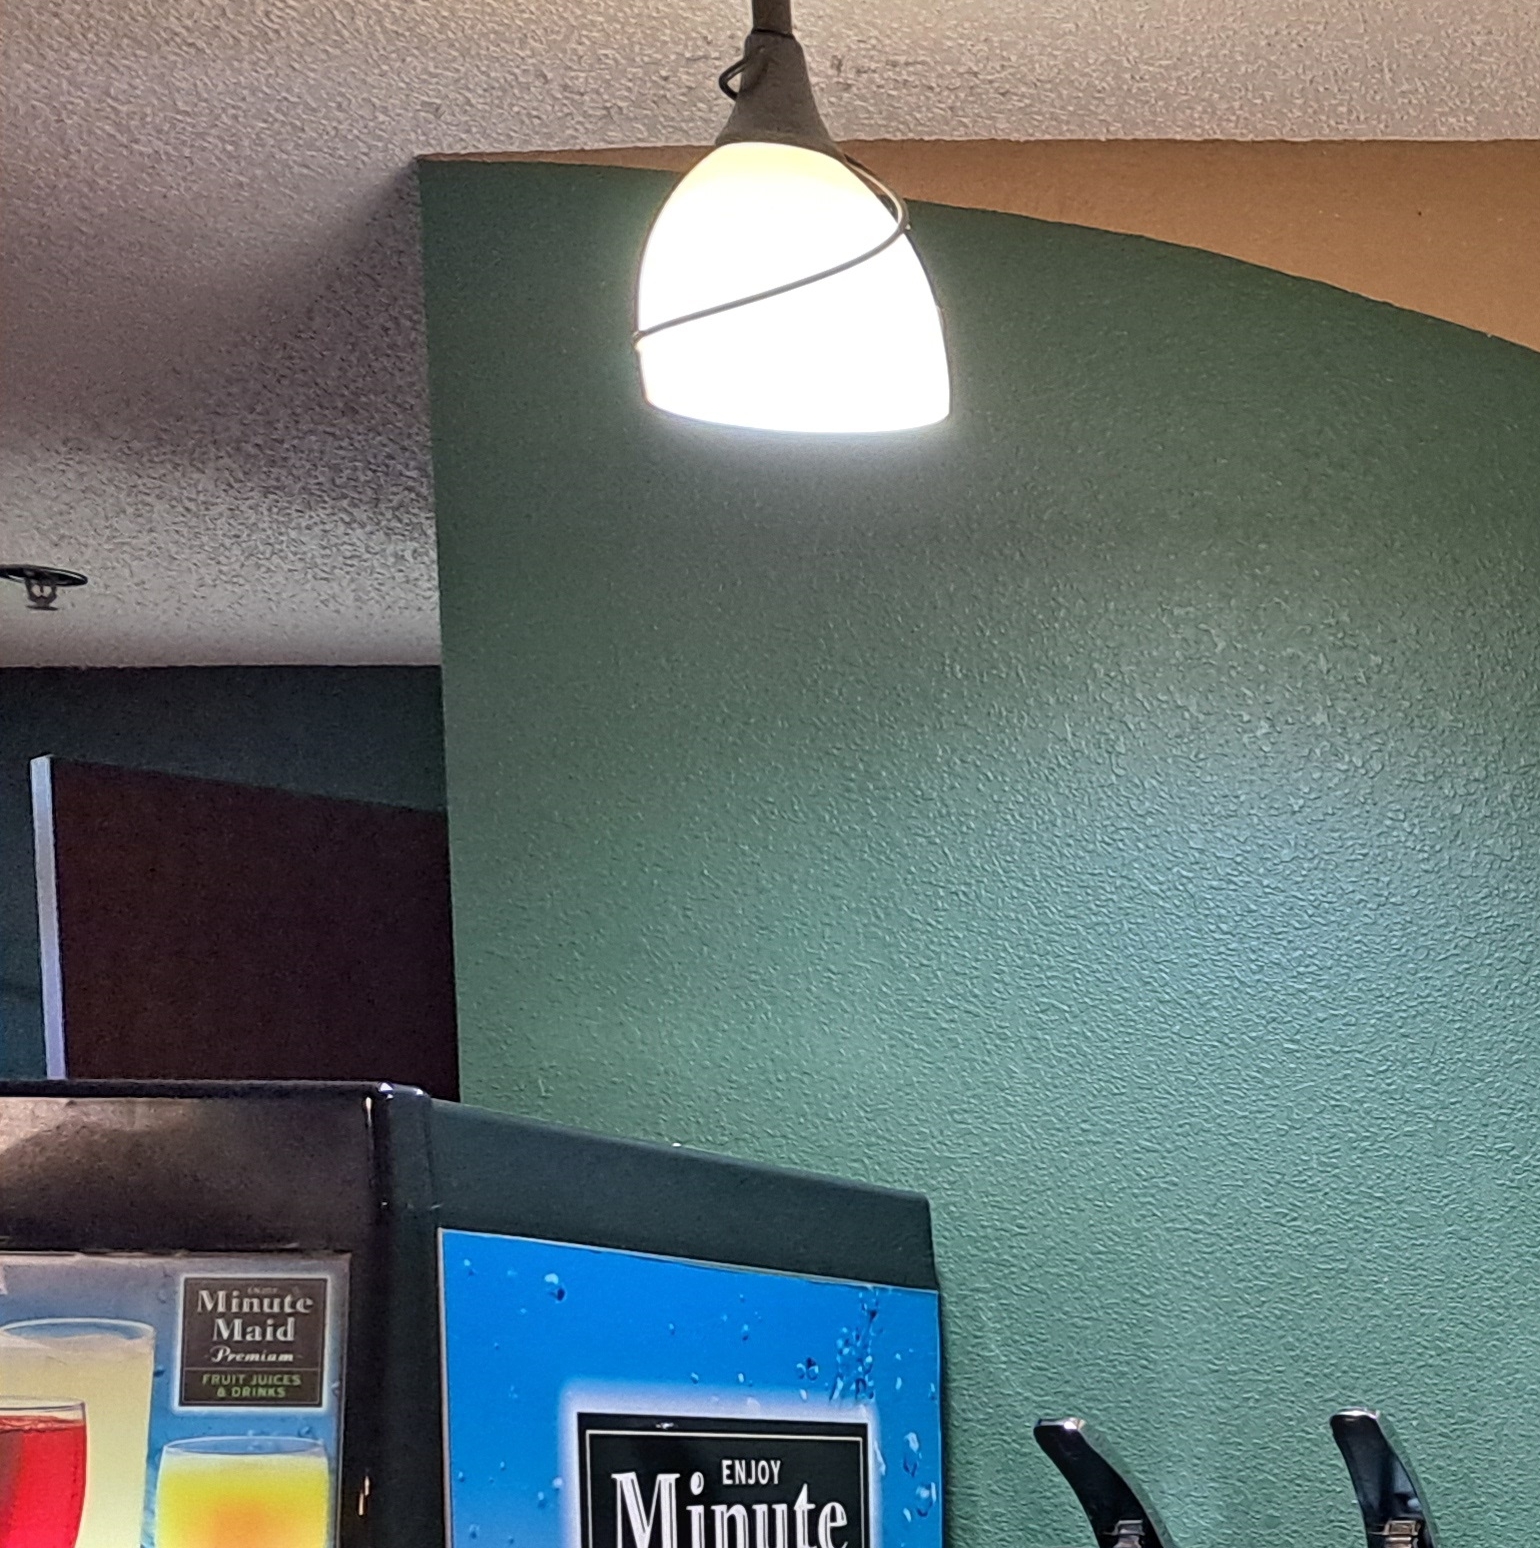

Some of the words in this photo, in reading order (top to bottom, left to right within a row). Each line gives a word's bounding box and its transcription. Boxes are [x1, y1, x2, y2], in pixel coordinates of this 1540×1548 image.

[197, 1289, 314, 1314] Minute
[212, 1317, 296, 1342] Maid
[202, 1373, 246, 1386] FRUIT
[250, 1373, 302, 1386] JUICES
[216, 1387, 226, 1397] &
[231, 1387, 286, 1398] DRINKS
[720, 1459, 782, 1486] ENJOY
